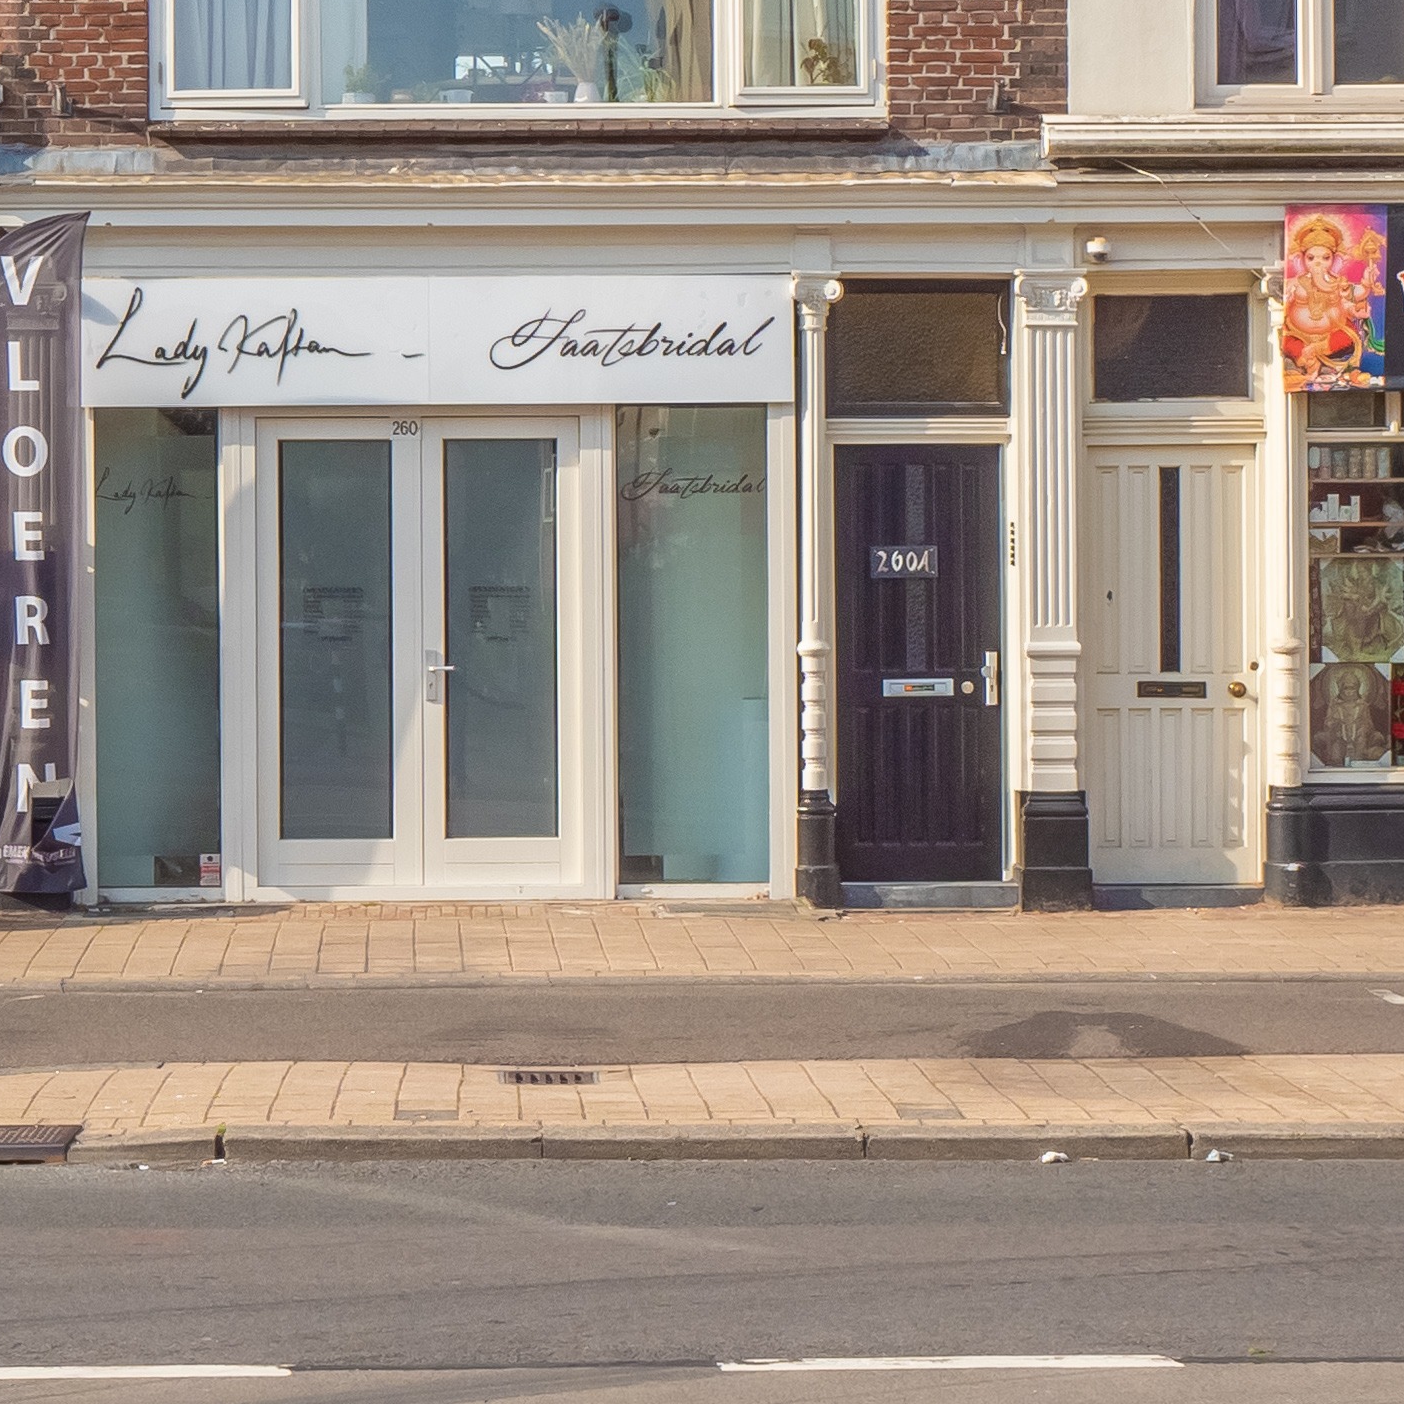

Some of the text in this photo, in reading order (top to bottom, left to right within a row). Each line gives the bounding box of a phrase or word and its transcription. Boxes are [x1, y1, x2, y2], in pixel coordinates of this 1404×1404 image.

[95, 286, 208, 400] Lady
[217, 308, 373, 385] Kaftan
[392, 420, 419, 436] 260
[0, 255, 56, 813] VLOEREN
